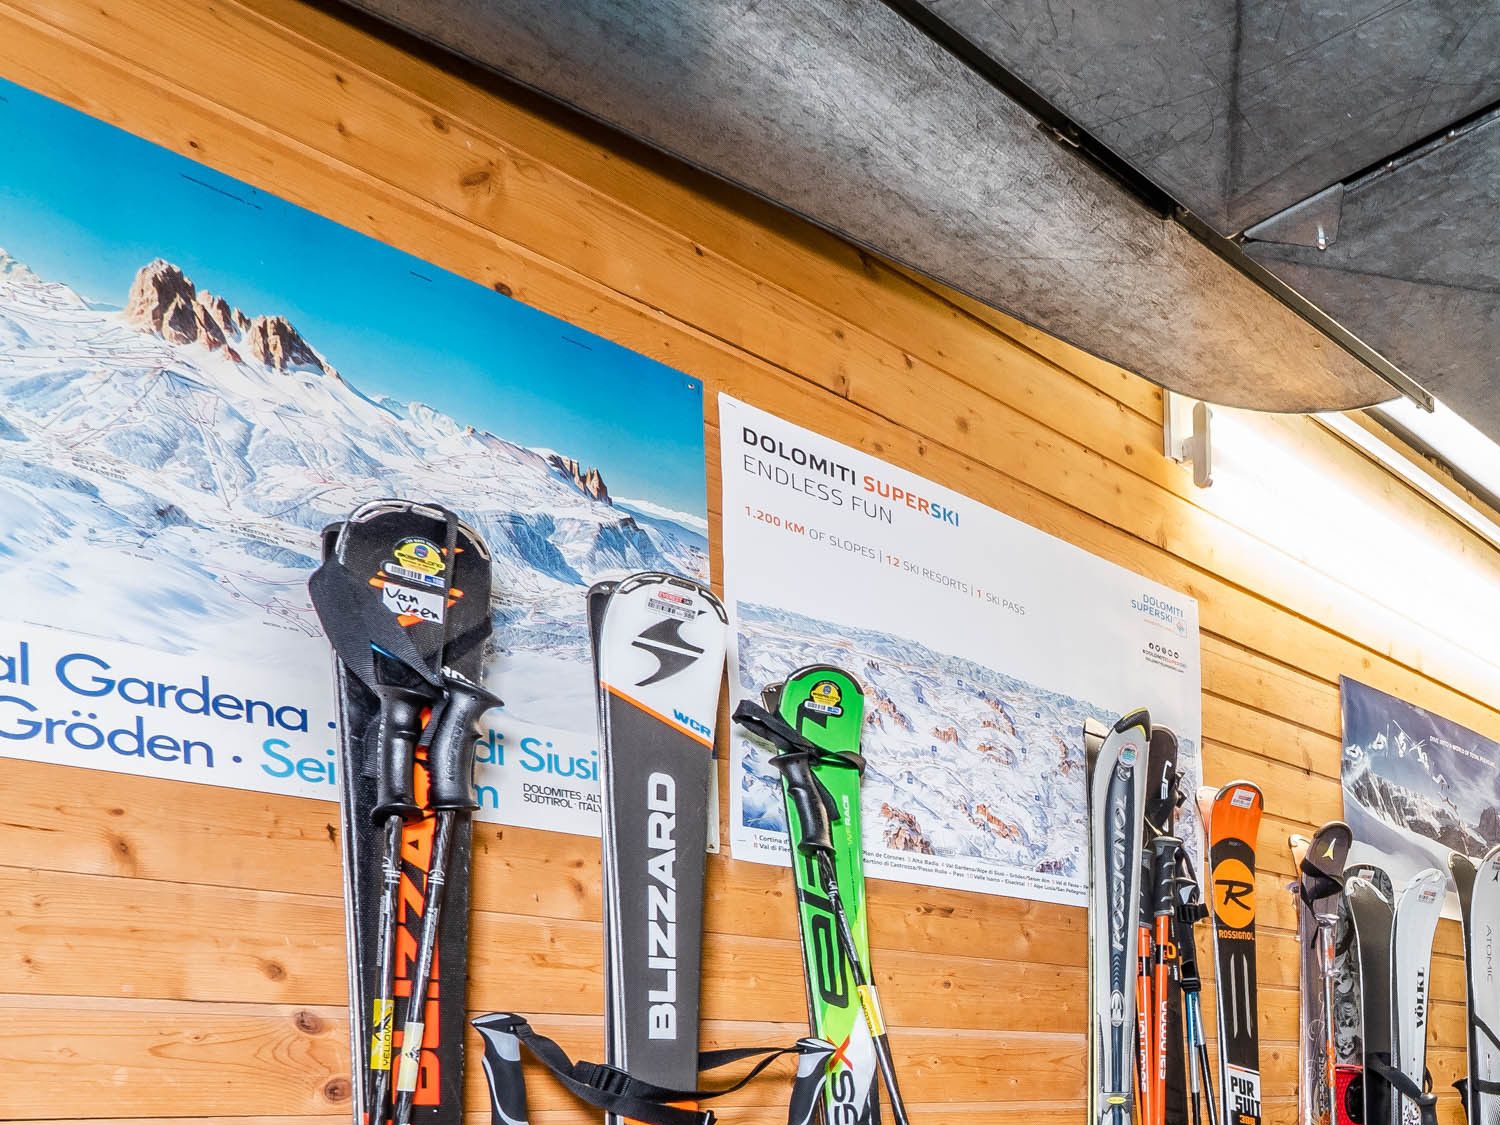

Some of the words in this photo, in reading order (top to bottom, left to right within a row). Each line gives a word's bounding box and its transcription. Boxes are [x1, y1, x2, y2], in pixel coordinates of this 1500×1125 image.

[743, 426, 856, 486] DOLOMITI
[863, 475, 960, 528] SUPERSKI
[743, 454, 844, 506] ENDLESS
[852, 495, 893, 525] FUN
[744, 505, 781, 527] 1.200
[785, 519, 806, 536] KM
[809, 528, 825, 541] OF
[829, 535, 876, 559] SLOPES
[885, 555, 900, 568] 12
[903, 560, 920, 575] SKI
[922, 567, 968, 593] RESORTS
[976, 589, 984, 599] 1
[986, 592, 1000, 606] SKI
[1002, 599, 1026, 616] PASS
[385, 587, 419, 604] Van
[1131, 600, 1173, 624] SUPERSKI
[1143, 594, 1184, 618] DOLOMITI
[0, 641, 30, 686] al
[55, 653, 308, 732] Gardena
[475, 729, 505, 766] di
[519, 737, 598, 782] Siusi
[673, 708, 712, 738] WCR
[0, 695, 214, 768] Gröden
[261, 738, 336, 784] Sei
[523, 783, 582, 801] DOLOMITES
[586, 793, 601, 803] ALT
[523, 792, 573, 809] SÜDTIROL
[578, 801, 602, 813] ITALY
[759, 834, 783, 845] Cortina
[759, 843, 770, 851] Val
[771, 843, 778, 851] di
[1112, 794, 1127, 952] ROSSIGNOL
[392, 745, 441, 1106] BLIZZA
[647, 771, 677, 1040] BLIZZARD
[1218, 929, 1256, 941] ROSSIGNOL
[1485, 924, 1494, 985] ATOMIC
[1414, 966, 1425, 1029] VÖLKL
[382, 1024, 392, 1067] YELLOW
[1159, 1000, 1168, 1081] salomon
[1230, 1075, 1255, 1098] PUR
[1235, 1094, 1261, 1117] SUIT
